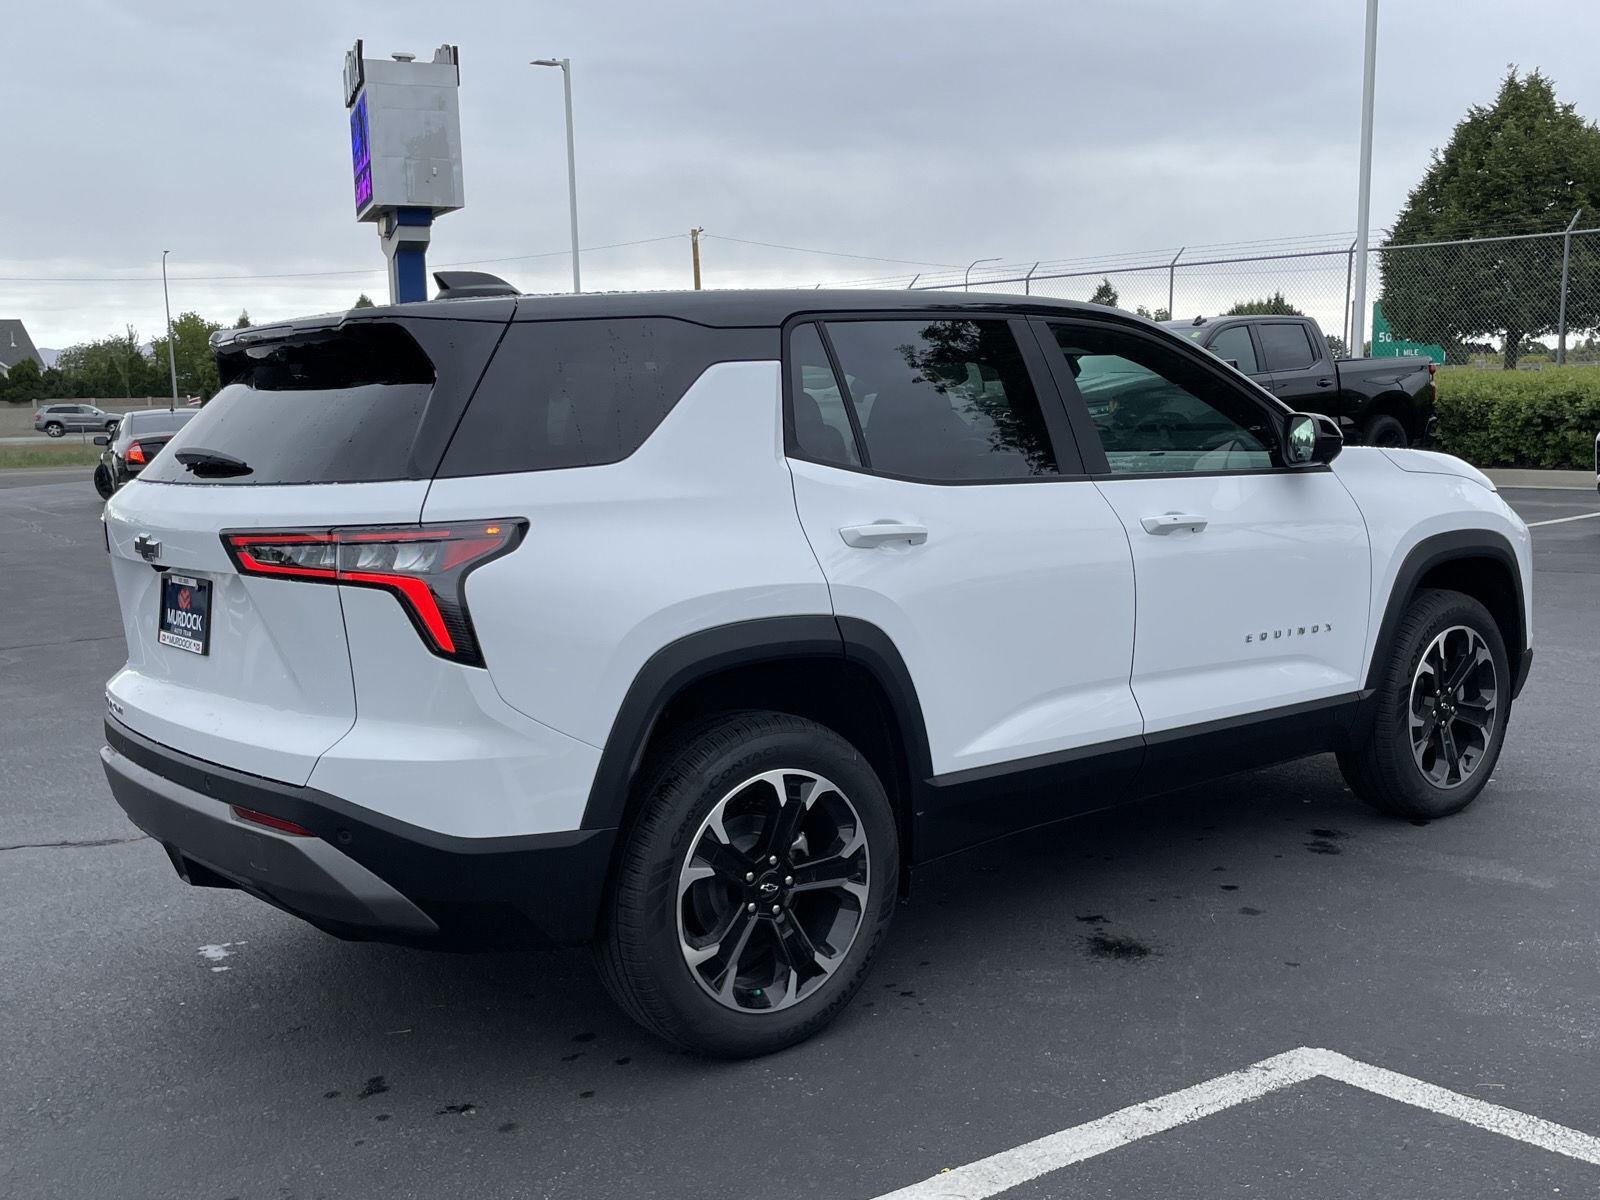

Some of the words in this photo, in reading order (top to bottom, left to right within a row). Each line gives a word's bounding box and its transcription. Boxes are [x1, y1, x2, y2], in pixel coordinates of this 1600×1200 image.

[1403, 348, 1420, 356] MILE
[167, 607, 202, 632] MURDOCK
[1245, 623, 1333, 643] EQUINOX
